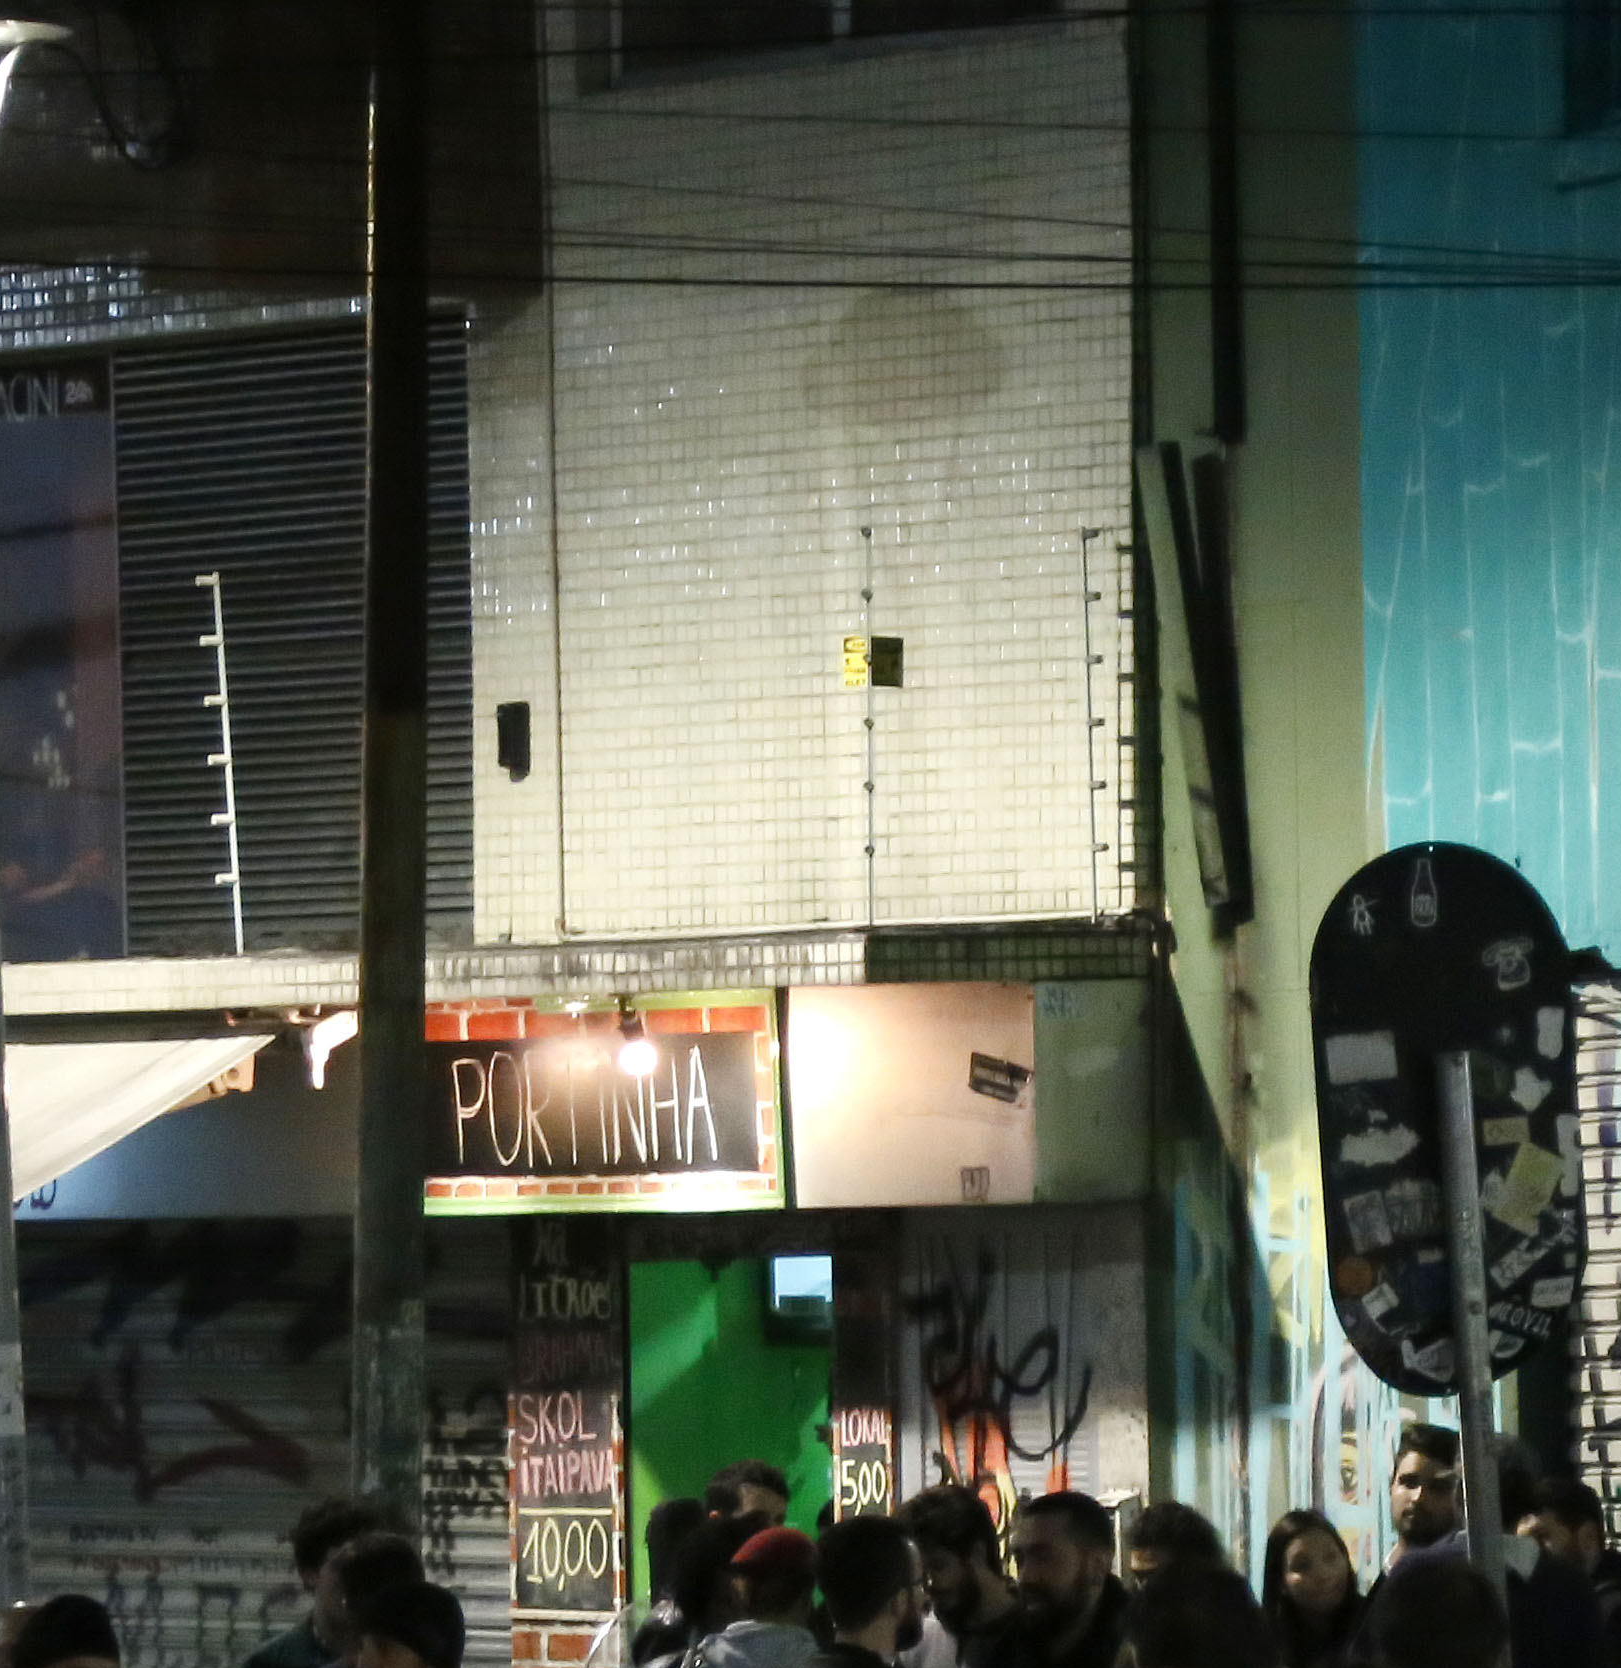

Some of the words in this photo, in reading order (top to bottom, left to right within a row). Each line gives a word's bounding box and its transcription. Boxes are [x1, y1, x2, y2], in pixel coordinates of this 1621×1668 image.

[451, 1045, 718, 1168] PORTINHA
[519, 1391, 597, 1444] SKOL
[841, 1409, 888, 1446] LOKAL
[841, 1460, 887, 1516] 5,00
[522, 1517, 608, 1591] 10,00
